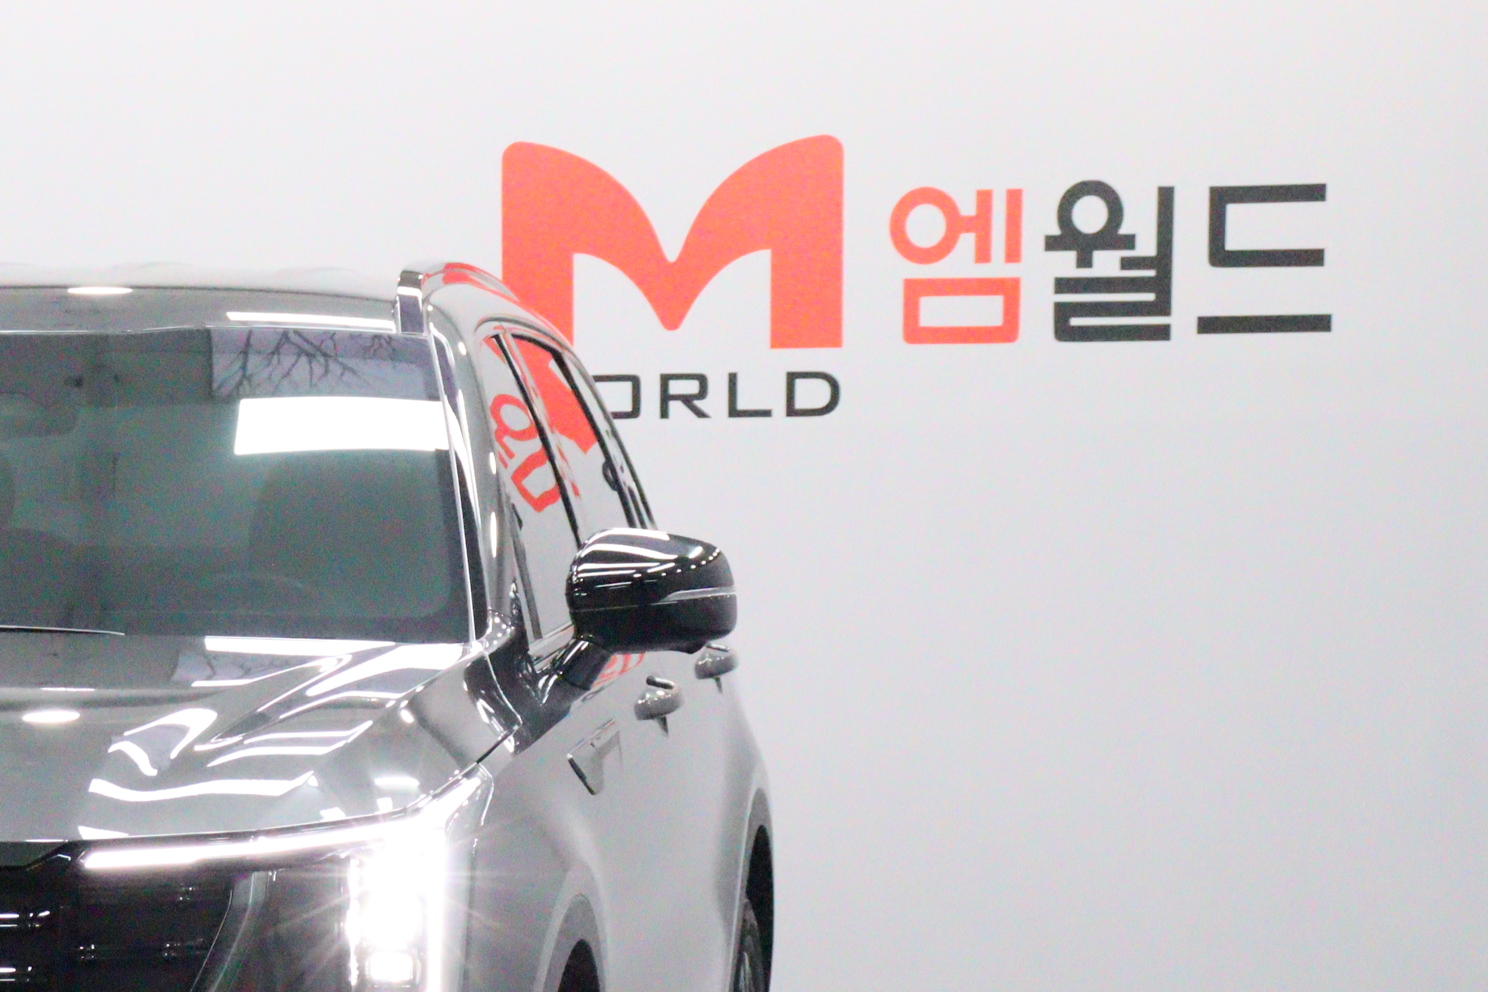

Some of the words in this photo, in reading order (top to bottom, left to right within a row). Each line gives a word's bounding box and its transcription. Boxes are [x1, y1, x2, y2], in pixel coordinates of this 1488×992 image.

[502, 134, 845, 350] M
[889, 180, 1332, 345] 엠월드
[592, 371, 841, 419] ORLD
